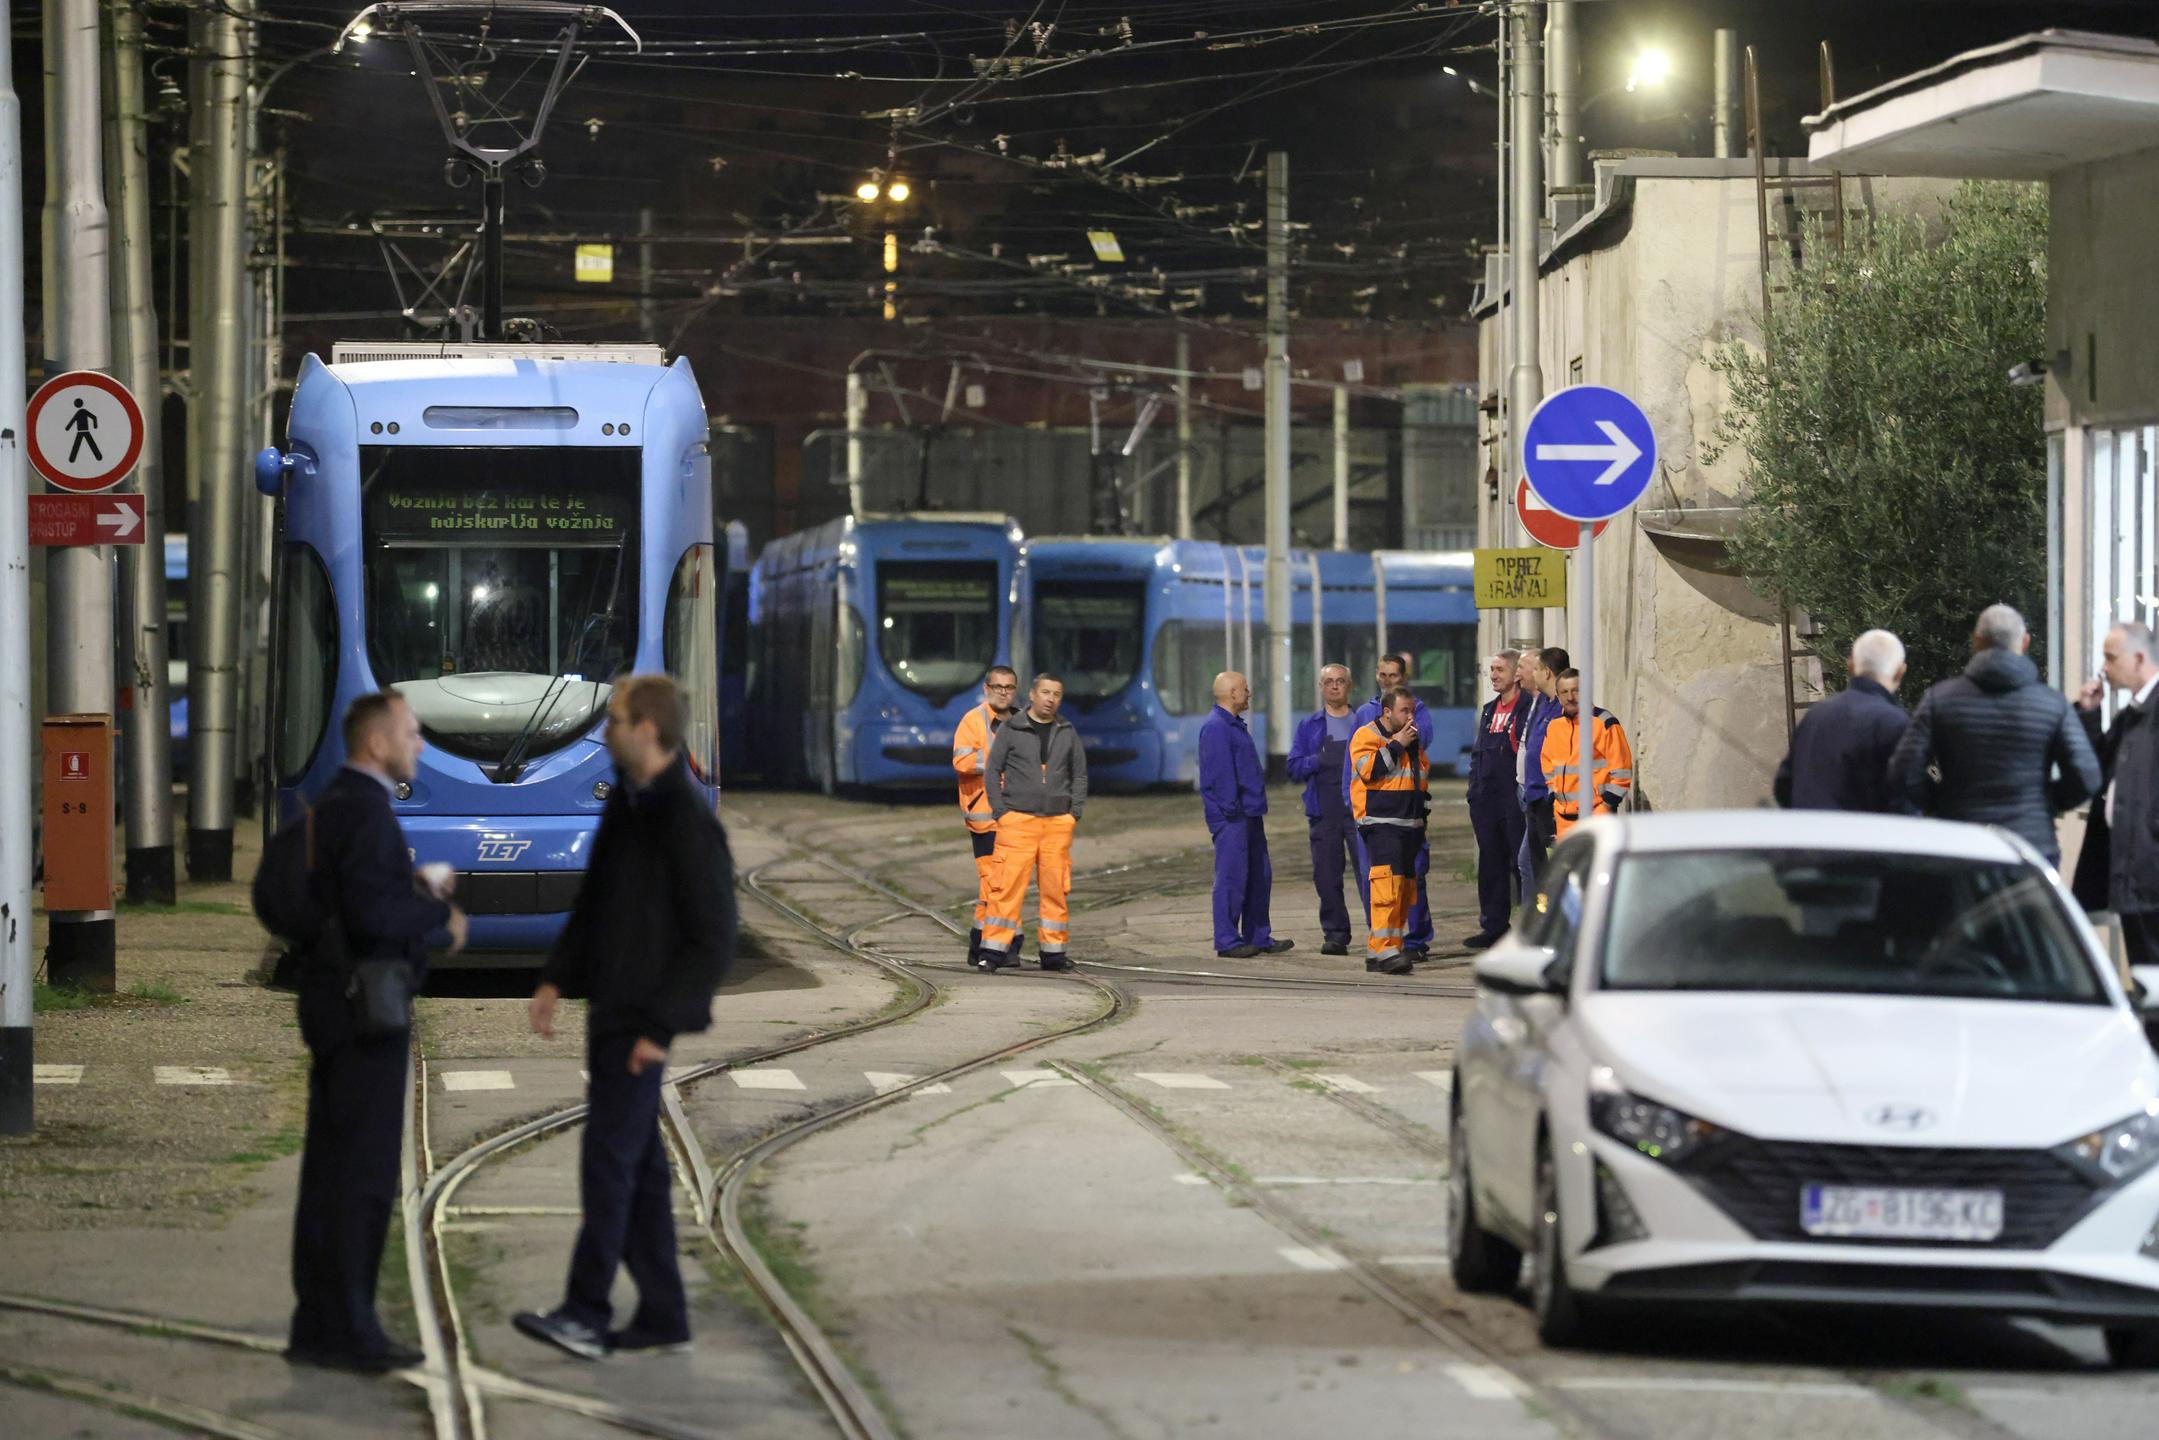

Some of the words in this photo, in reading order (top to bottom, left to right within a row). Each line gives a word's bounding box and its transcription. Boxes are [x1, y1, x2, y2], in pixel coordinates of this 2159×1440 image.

[566, 494, 586, 509] je
[546, 511, 614, 529] vožnja
[1495, 557, 1542, 577] OPREZ
[477, 840, 533, 862] ZET
